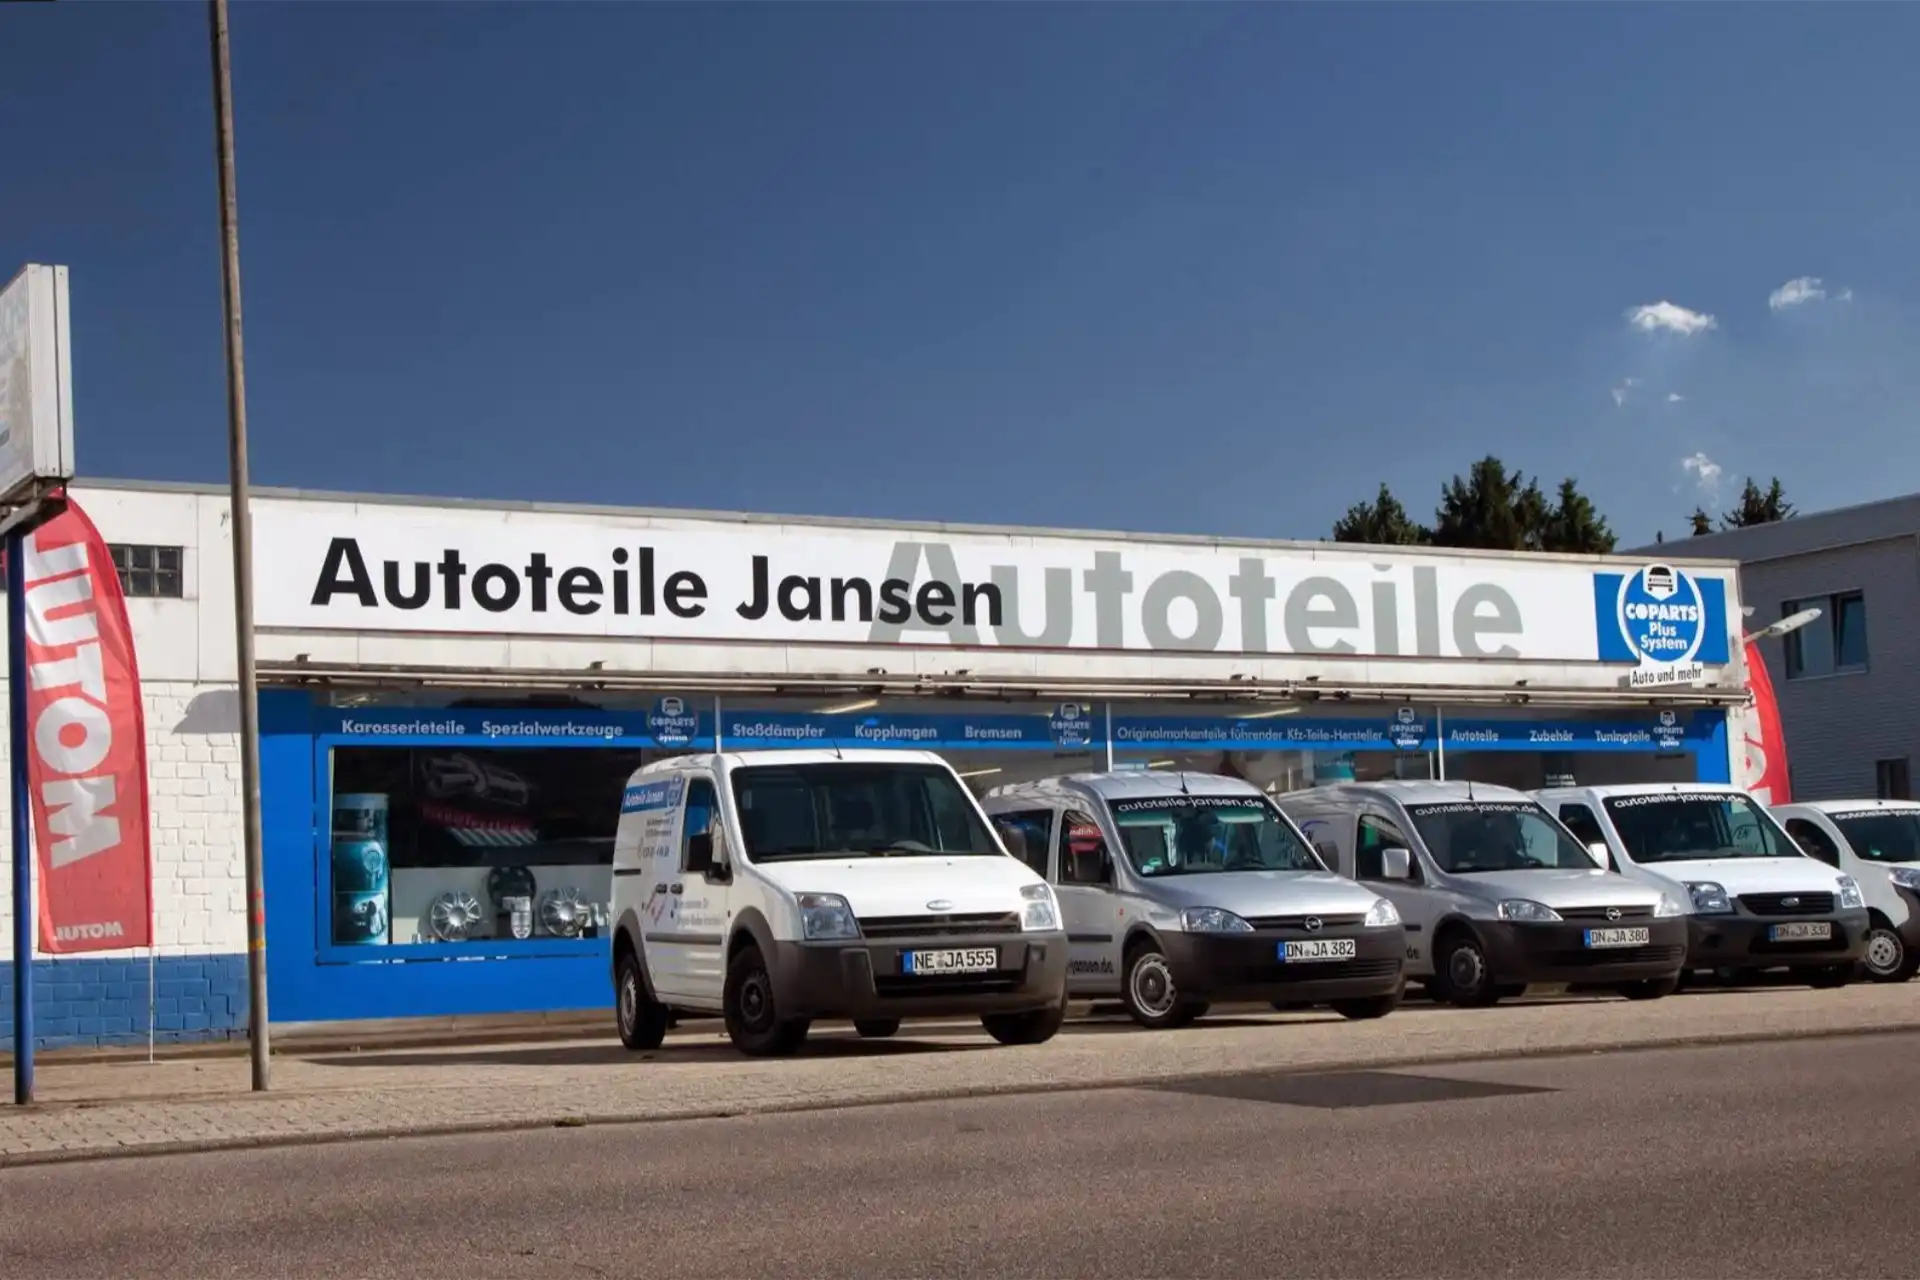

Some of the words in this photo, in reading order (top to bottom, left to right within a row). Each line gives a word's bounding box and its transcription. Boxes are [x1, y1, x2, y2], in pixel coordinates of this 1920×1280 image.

[310, 537, 708, 616] Autoteile
[735, 554, 1003, 626] Jansen
[867, 541, 1524, 659] Autoteile
[1625, 602, 1698, 621] COPARTS
[1648, 620, 1677, 637] Plus
[1640, 633, 1688, 653] System
[1631, 670, 1655, 685] Auto
[1657, 665, 1675, 682] und
[1677, 663, 1703, 680] mehr
[341, 719, 466, 735] Karosserieteile
[481, 720, 624, 740] Spezialwerkzeuge
[732, 723, 826, 740] Stoßdämpfer
[854, 724, 938, 742] Kupplungen
[964, 725, 1023, 739] Bremsen
[1117, 726, 1228, 742] Originalmarkenteile
[1231, 727, 1283, 741] führender
[1286, 727, 1384, 741] Kfz-Teile-Hersteller
[1450, 729, 1500, 742] Autoteile
[1529, 729, 1575, 742] Zubehör
[1594, 730, 1651, 744] Tuningteile
[1117, 796, 1265, 813] autoteile-jansen.de
[1613, 791, 1748, 808] autoteile-jansen.de
[1591, 931, 1606, 944] DN
[1611, 930, 1627, 943] JA
[1286, 944, 1304, 957] DN
[1312, 942, 1328, 956] JA
[1331, 941, 1354, 955] 382
[914, 952, 935, 969] NE
